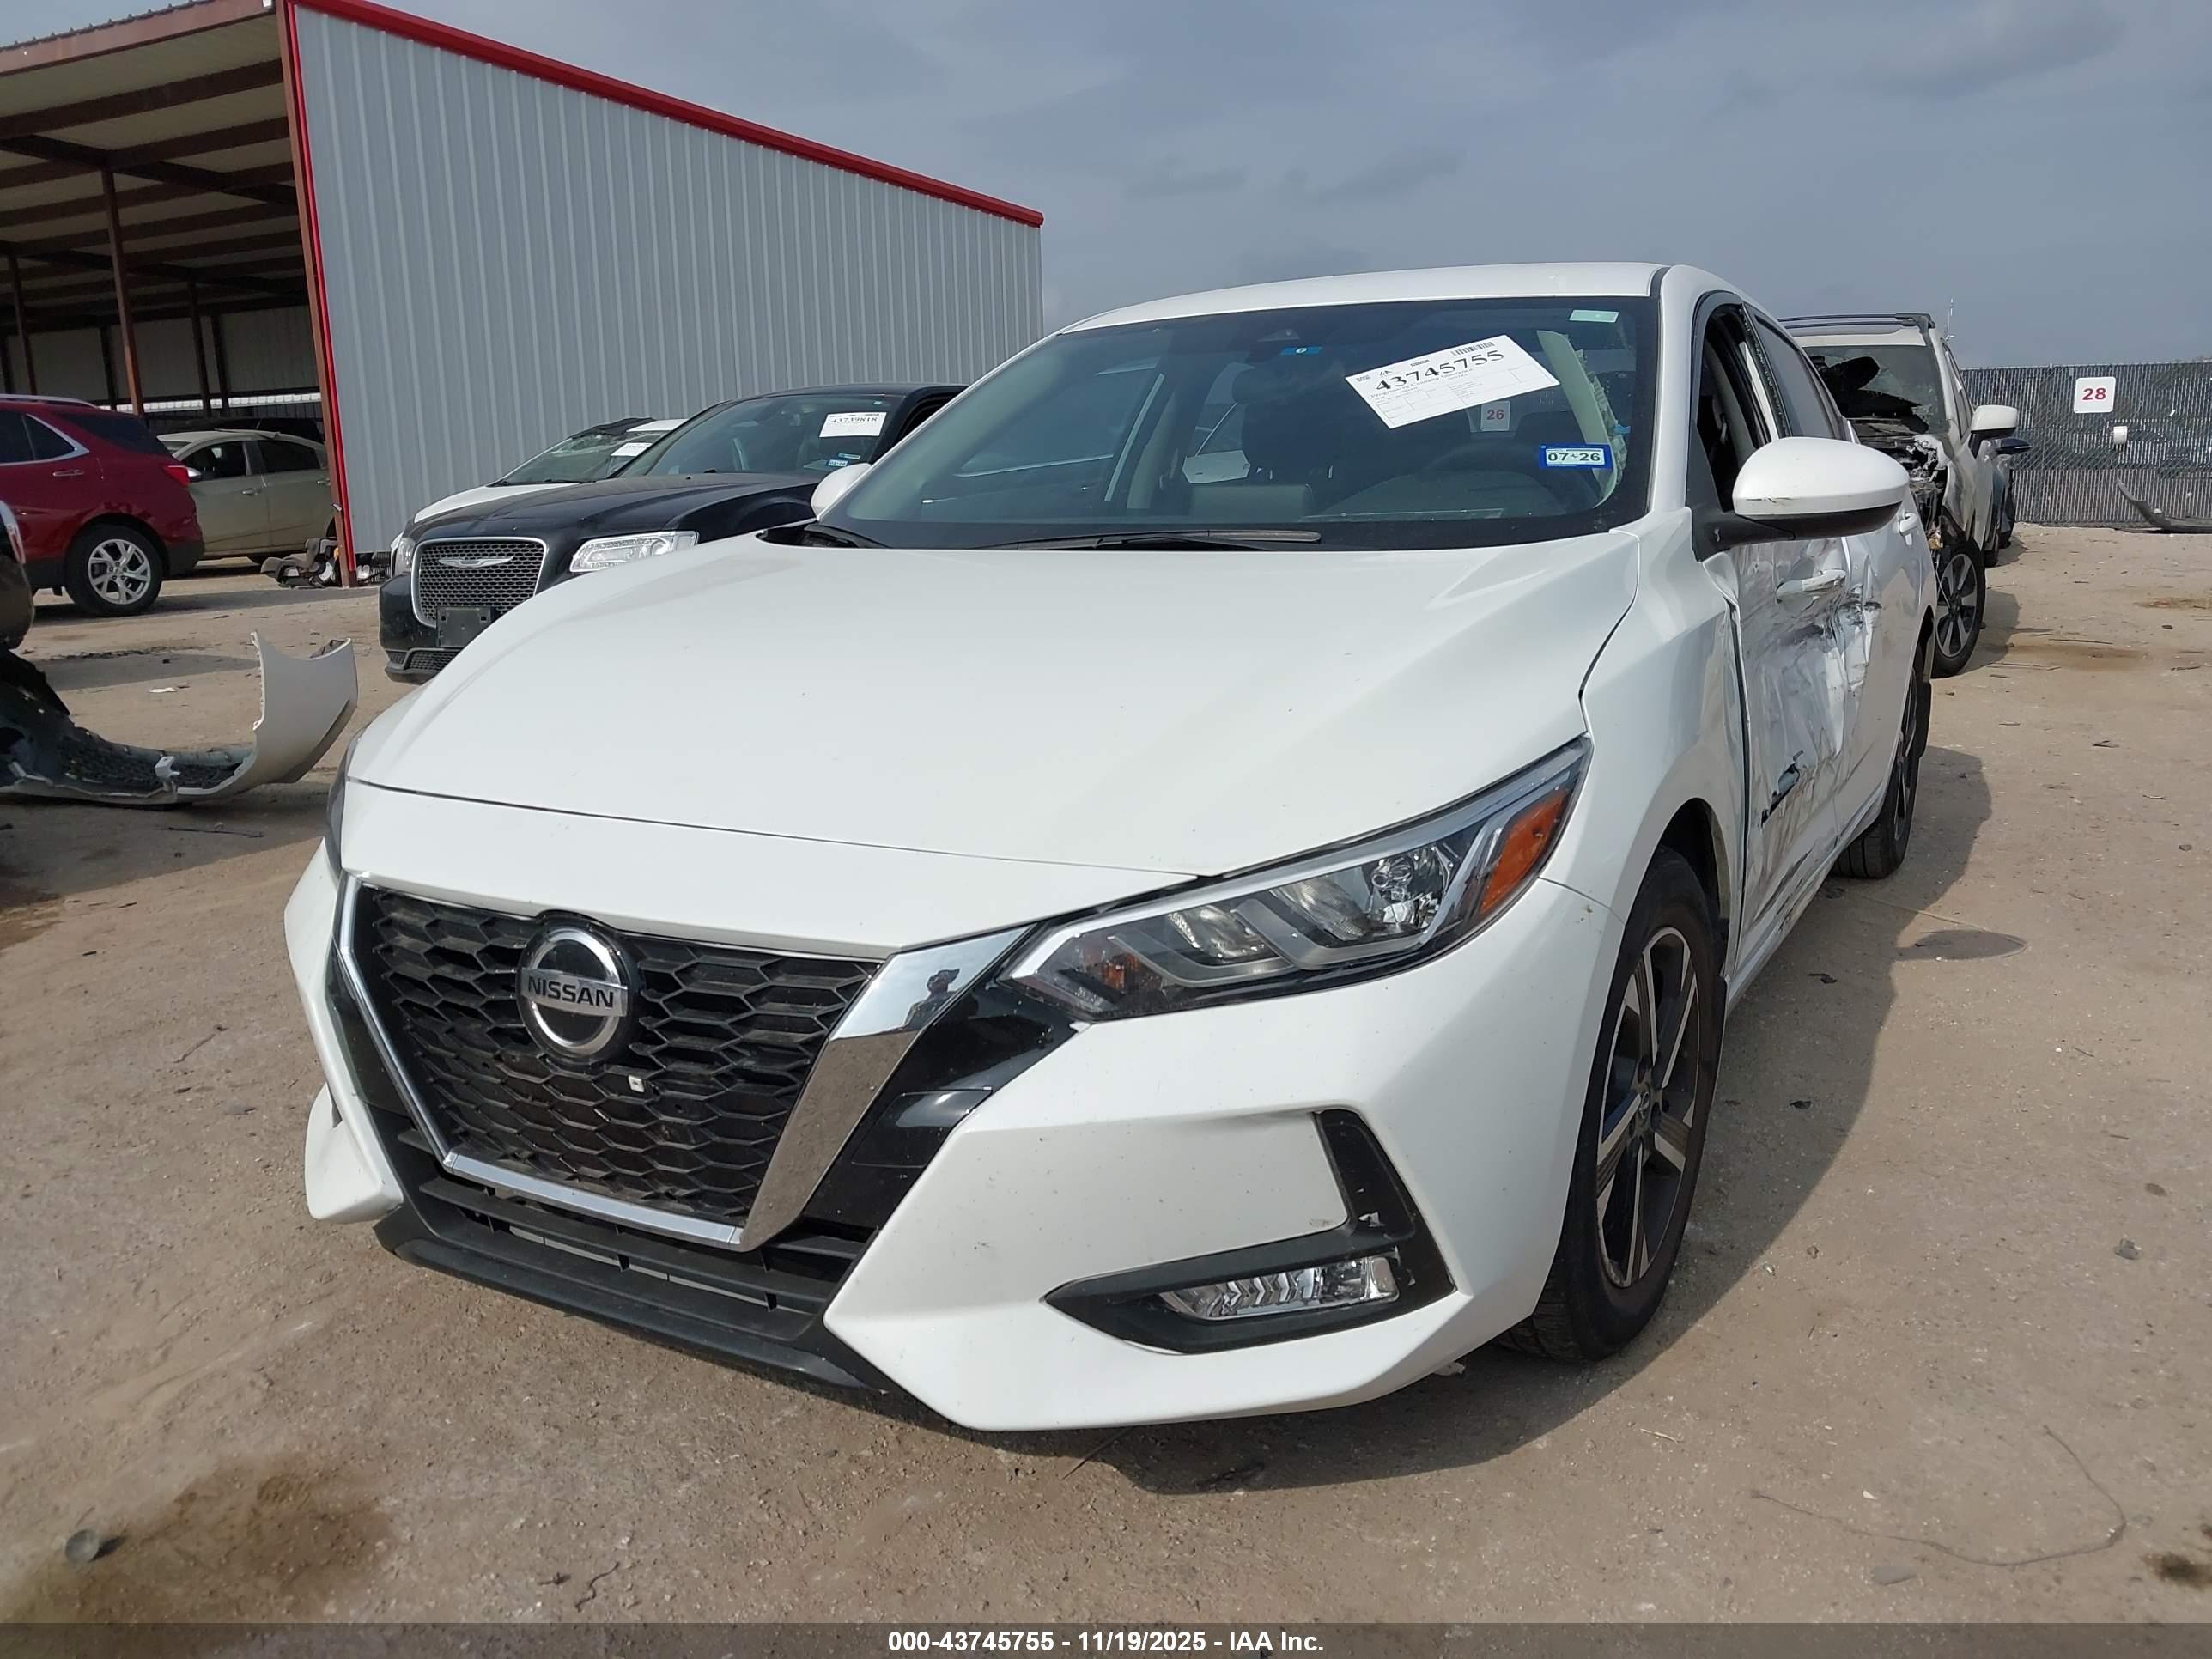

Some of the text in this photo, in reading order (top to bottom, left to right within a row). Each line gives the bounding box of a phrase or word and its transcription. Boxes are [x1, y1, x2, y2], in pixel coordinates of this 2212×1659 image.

[1376, 349, 1504, 392] 43745755
[2082, 387, 2106, 401] 28
[1486, 409, 1504, 421] 26
[527, 975, 615, 1008] NISSAN
